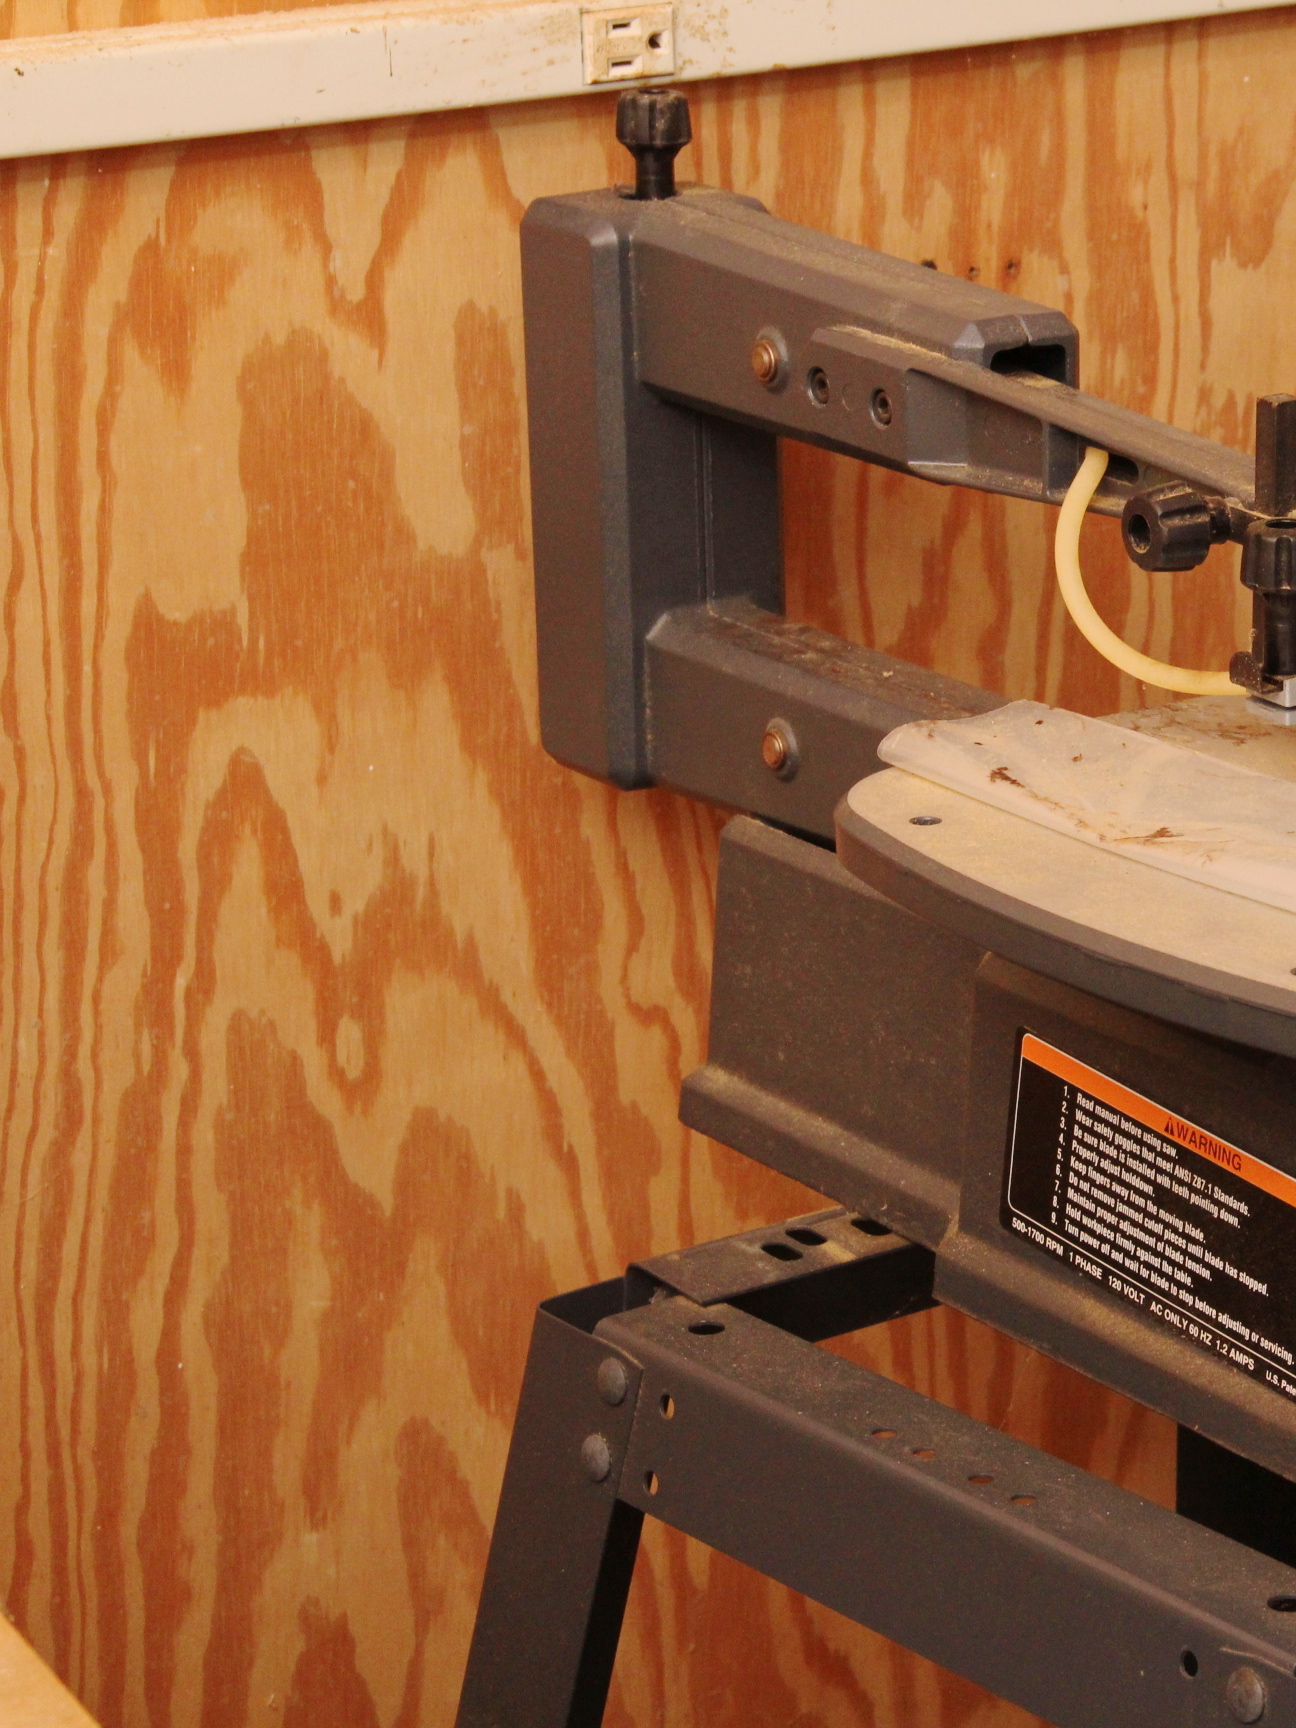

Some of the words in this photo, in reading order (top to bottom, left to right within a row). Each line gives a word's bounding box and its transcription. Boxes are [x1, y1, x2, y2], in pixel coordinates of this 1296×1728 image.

[1058, 1132, 1066, 1146] 4.
[1071, 1139, 1100, 1167] Properly
[1099, 1158, 1121, 1178] adjust
[1120, 1167, 1155, 1198] holddown.
[1059, 1116, 1067, 1131] 3.
[1073, 1124, 1083, 1139] Be
[1083, 1132, 1099, 1148] sure
[1098, 1138, 1118, 1159] blade
[1118, 1149, 1126, 1164] is
[1126, 1153, 1156, 1181] installed
[1156, 1173, 1171, 1189] with
[1171, 1180, 1190, 1200] teeth
[1189, 1192, 1219, 1219] pointing
[1219, 1207, 1241, 1229] down.
[1061, 1100, 1069, 1115] 2.
[1075, 1108, 1094, 1128] Wear
[1093, 1121, 1114, 1142] safety
[1114, 1133, 1141, 1156] goggles
[1141, 1146, 1155, 1164] that
[1155, 1156, 1174, 1174] meet
[1173, 1164, 1192, 1184] ANSI
[1192, 1174, 1212, 1195] Z87.1
[1213, 1186, 1251, 1217] Standards.
[1063, 1085, 1070, 1099] 1.
[1076, 1092, 1095, 1112] Read
[1094, 1104, 1120, 1127] manual
[1120, 1116, 1142, 1139] before
[1142, 1131, 1162, 1152] using
[1162, 1142, 1179, 1160] saw.
[1176, 1121, 1243, 1172] WARNING
[1052, 1195, 1060, 1209] 8.
[1065, 1202, 1082, 1222] Hold
[1081, 1214, 1115, 1242] workpiece
[1115, 1232, 1136, 1256] firmly
[1135, 1246, 1162, 1269] against
[1161, 1259, 1173, 1276] the
[1173, 1266, 1194, 1288] table.
[1054, 1179, 1062, 1194] 7.
[1067, 1186, 1096, 1214] Maintain
[1096, 1206, 1119, 1226] proper
[1118, 1219, 1157, 1249] adjustment
[1156, 1241, 1165, 1253] of
[1164, 1243, 1185, 1265] blade
[1184, 1255, 1213, 1282] tension.
[1055, 1163, 1063, 1178] 6.
[1068, 1171, 1079, 1187] Do
[1078, 1179, 1091, 1194] not
[1090, 1186, 1116, 1208] remove
[1115, 1198, 1144, 1224] jammed
[1143, 1217, 1164, 1236] cutoff
[1163, 1228, 1187, 1250] pieces
[1187, 1242, 1204, 1259] until
[1204, 1249, 1224, 1271] blade
[1224, 1261, 1239, 1279] has
[1238, 1271, 1269, 1297] stopped.
[1056, 1147, 1064, 1162] 5.
[1070, 1155, 1087, 1176] Keep
[1087, 1165, 1111, 1189] fingers
[1111, 1181, 1130, 1201] away
[1129, 1189, 1146, 1209] from
[1146, 1199, 1158, 1216] the
[1158, 1208, 1184, 1233] moving
[1184, 1221, 1206, 1244] blade.
[1011, 1216, 1045, 1245] 500-1700
[1045, 1236, 1064, 1257] RPM
[1069, 1251, 1074, 1263] 1
[1074, 1254, 1103, 1280] PHASE
[1108, 1275, 1122, 1292] 120
[1123, 1283, 1146, 1305] VOLT
[1149, 1300, 1163, 1316] AC
[1163, 1308, 1189, 1331] ONLY
[1188, 1323, 1199, 1338] 60
[1199, 1329, 1213, 1346] HZ
[1215, 1339, 1229, 1356] 1.2
[1228, 1347, 1255, 1371] AMPS
[1050, 1211, 1058, 1226] 9.
[1064, 1218, 1079, 1238] Turn
[1079, 1230, 1101, 1250] power
[1100, 1243, 1111, 1256] off
[1110, 1249, 1124, 1264] and
[1124, 1256, 1139, 1274] wait
[1139, 1264, 1150, 1279] for
[1150, 1270, 1170, 1292] blade
[1170, 1282, 1178, 1296] to
[1178, 1289, 1194, 1307] stop
[1194, 1296, 1217, 1319] before
[1217, 1312, 1251, 1341] adjusting
[1250, 1331, 1260, 1344] or
[1259, 1337, 1295, 1366] servicing.
[1265, 1369, 1280, 1387] U.S.
